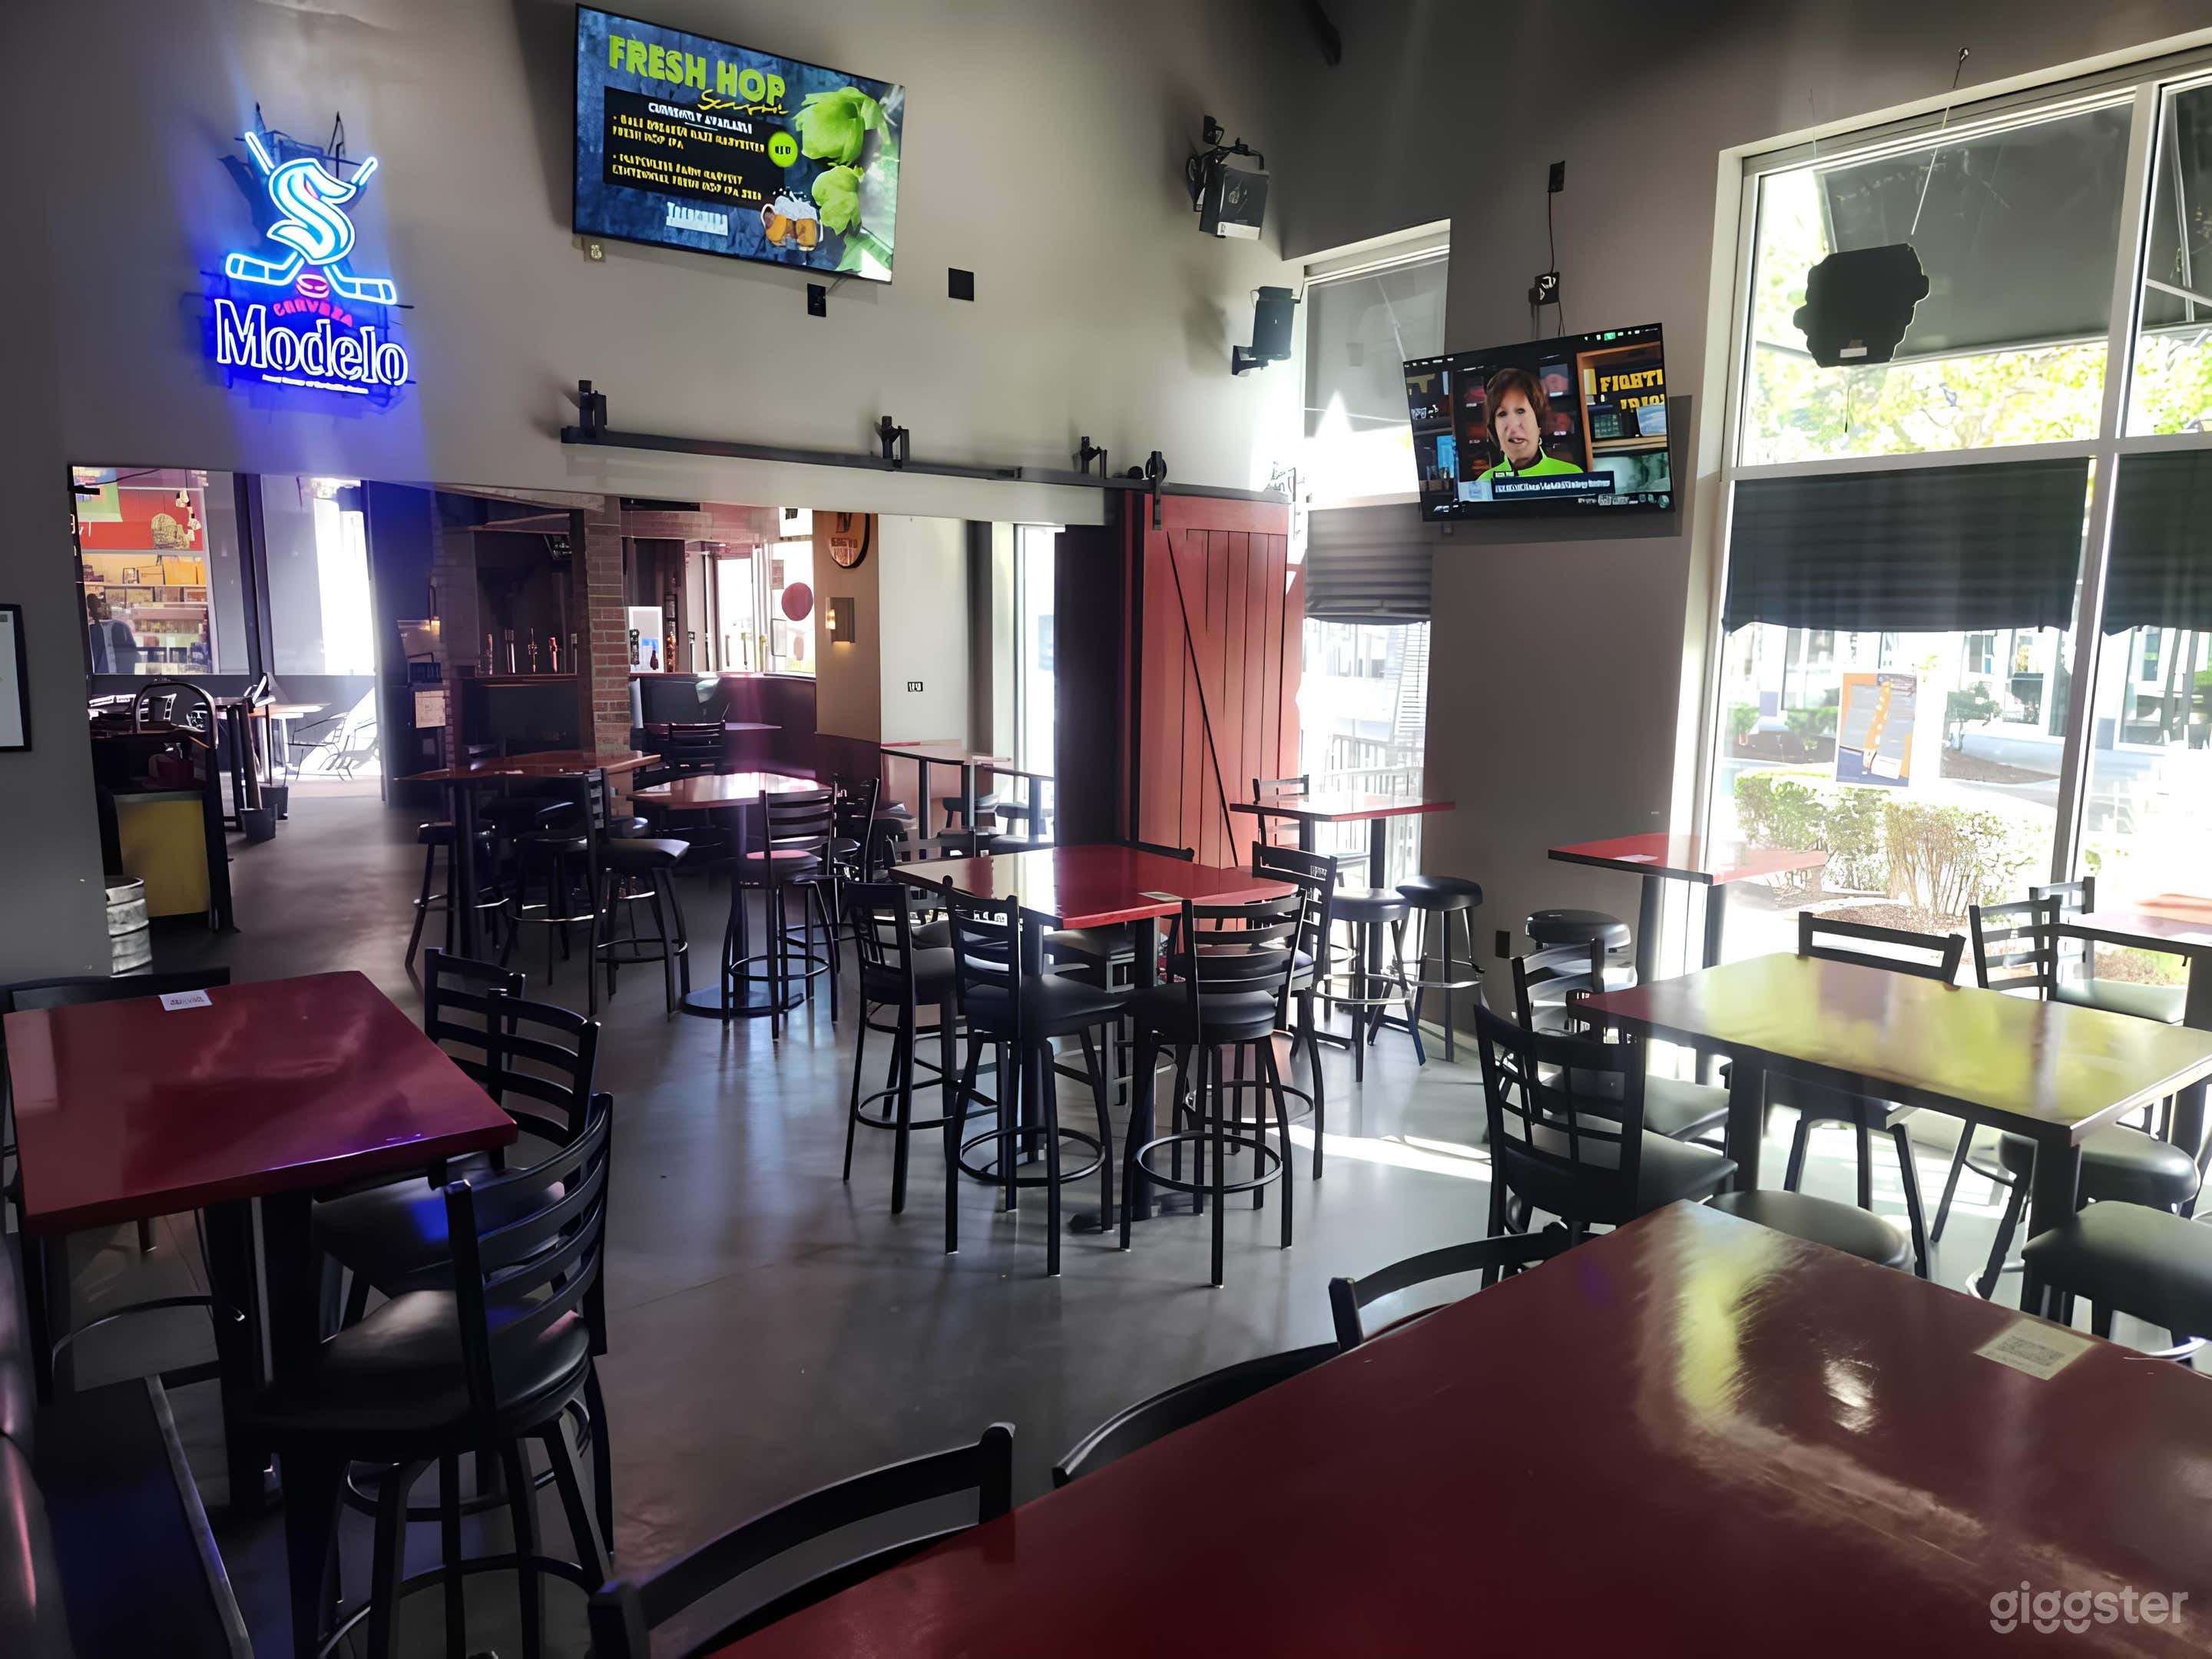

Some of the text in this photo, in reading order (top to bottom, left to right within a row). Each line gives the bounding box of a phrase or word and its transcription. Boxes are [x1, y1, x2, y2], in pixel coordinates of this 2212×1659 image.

[608, 35, 786, 107] FRESH HOP
[214, 298, 409, 386] Modelo
